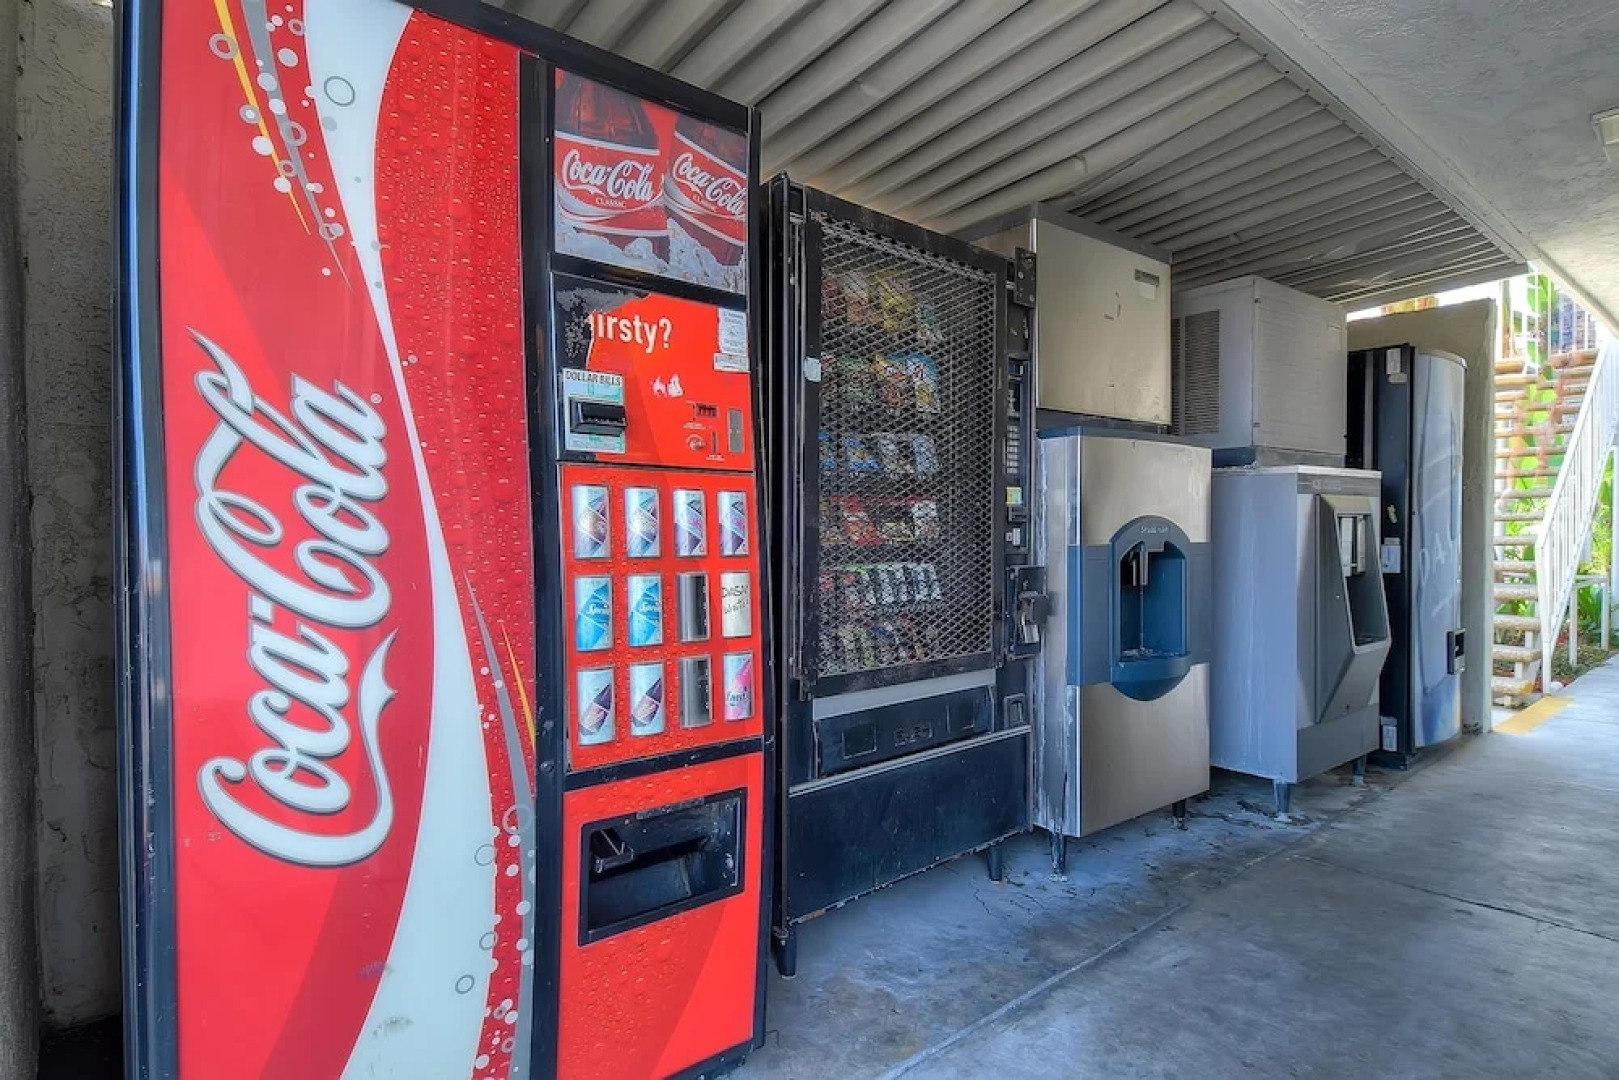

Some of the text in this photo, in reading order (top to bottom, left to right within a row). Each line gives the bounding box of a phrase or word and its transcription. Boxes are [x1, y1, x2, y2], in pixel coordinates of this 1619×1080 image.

[561, 149, 655, 202] Coca-Cola
[672, 153, 747, 215] Coca-Cola
[565, 370, 622, 386] DOLLAR BILLS
[186, 325, 398, 868] Coca-Cola
